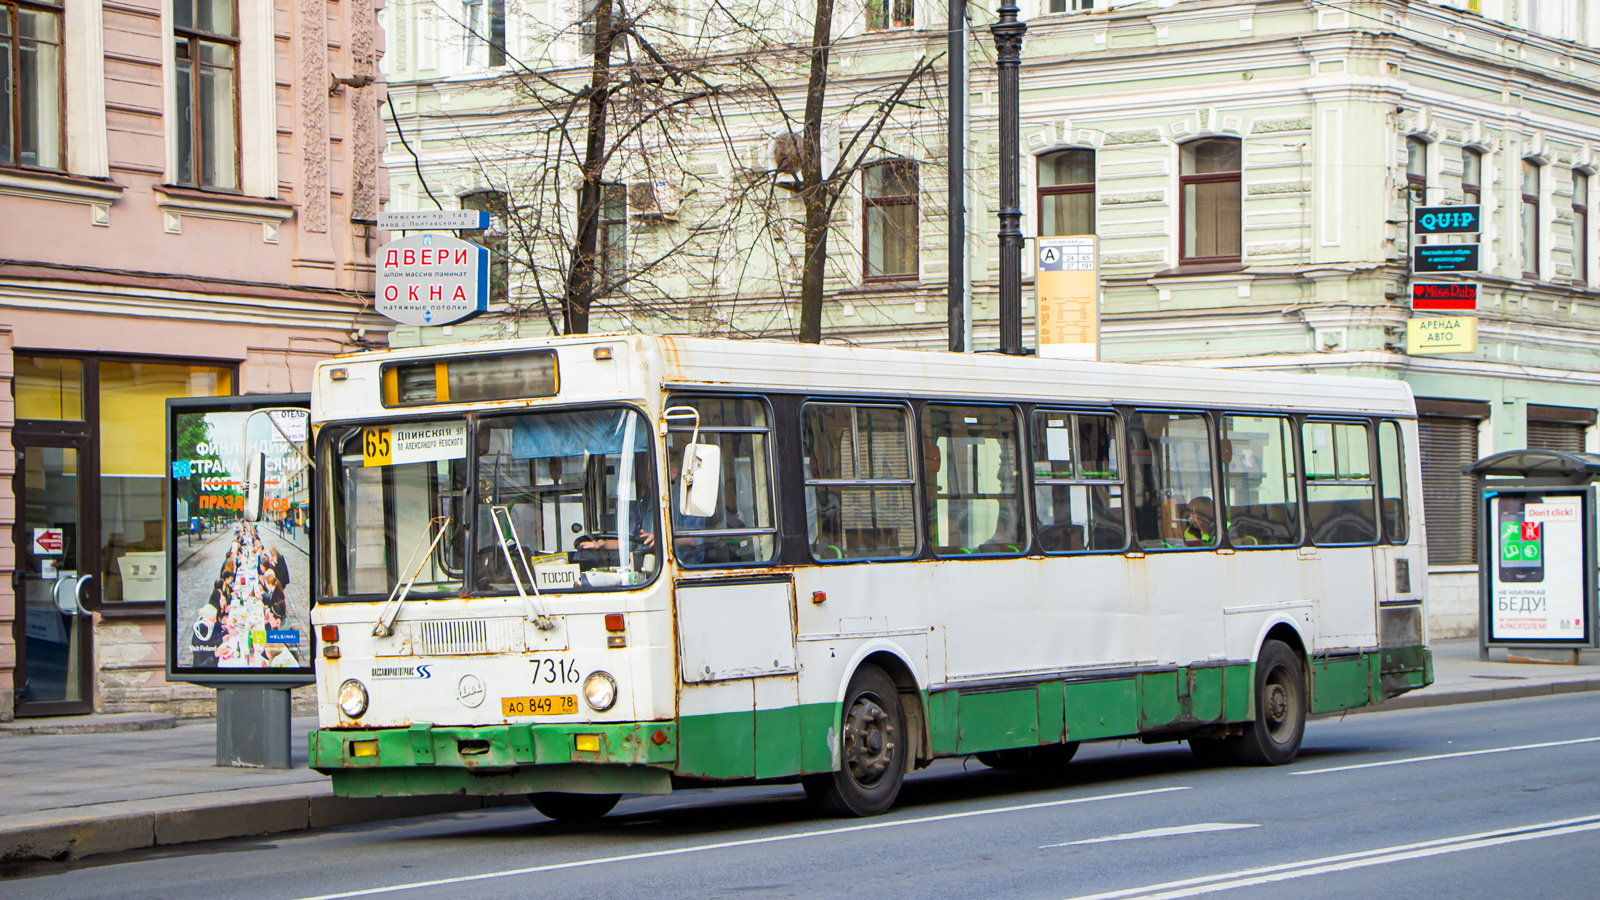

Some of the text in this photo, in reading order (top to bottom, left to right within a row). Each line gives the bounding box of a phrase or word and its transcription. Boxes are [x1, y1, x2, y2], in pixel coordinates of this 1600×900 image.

[1421, 212, 1473, 230] QUIP
[384, 249, 467, 268] ДВЕРИ
[1044, 248, 1055, 261] А
[384, 285, 467, 301] ОКНА
[1425, 284, 1476, 299] Miss Ruby
[1420, 320, 1461, 329] АРЕНДА
[1427, 332, 1454, 341] АВТО
[366, 428, 390, 458] 65
[199, 495, 289, 511] ПРАЗДКОВ
[1551, 508, 1573, 517] click!
[541, 571, 575, 584] ТОСОЛ
[1498, 596, 1546, 614] БЕДУ!
[529, 658, 580, 684] 7316
[509, 696, 573, 713] АО 849 78
